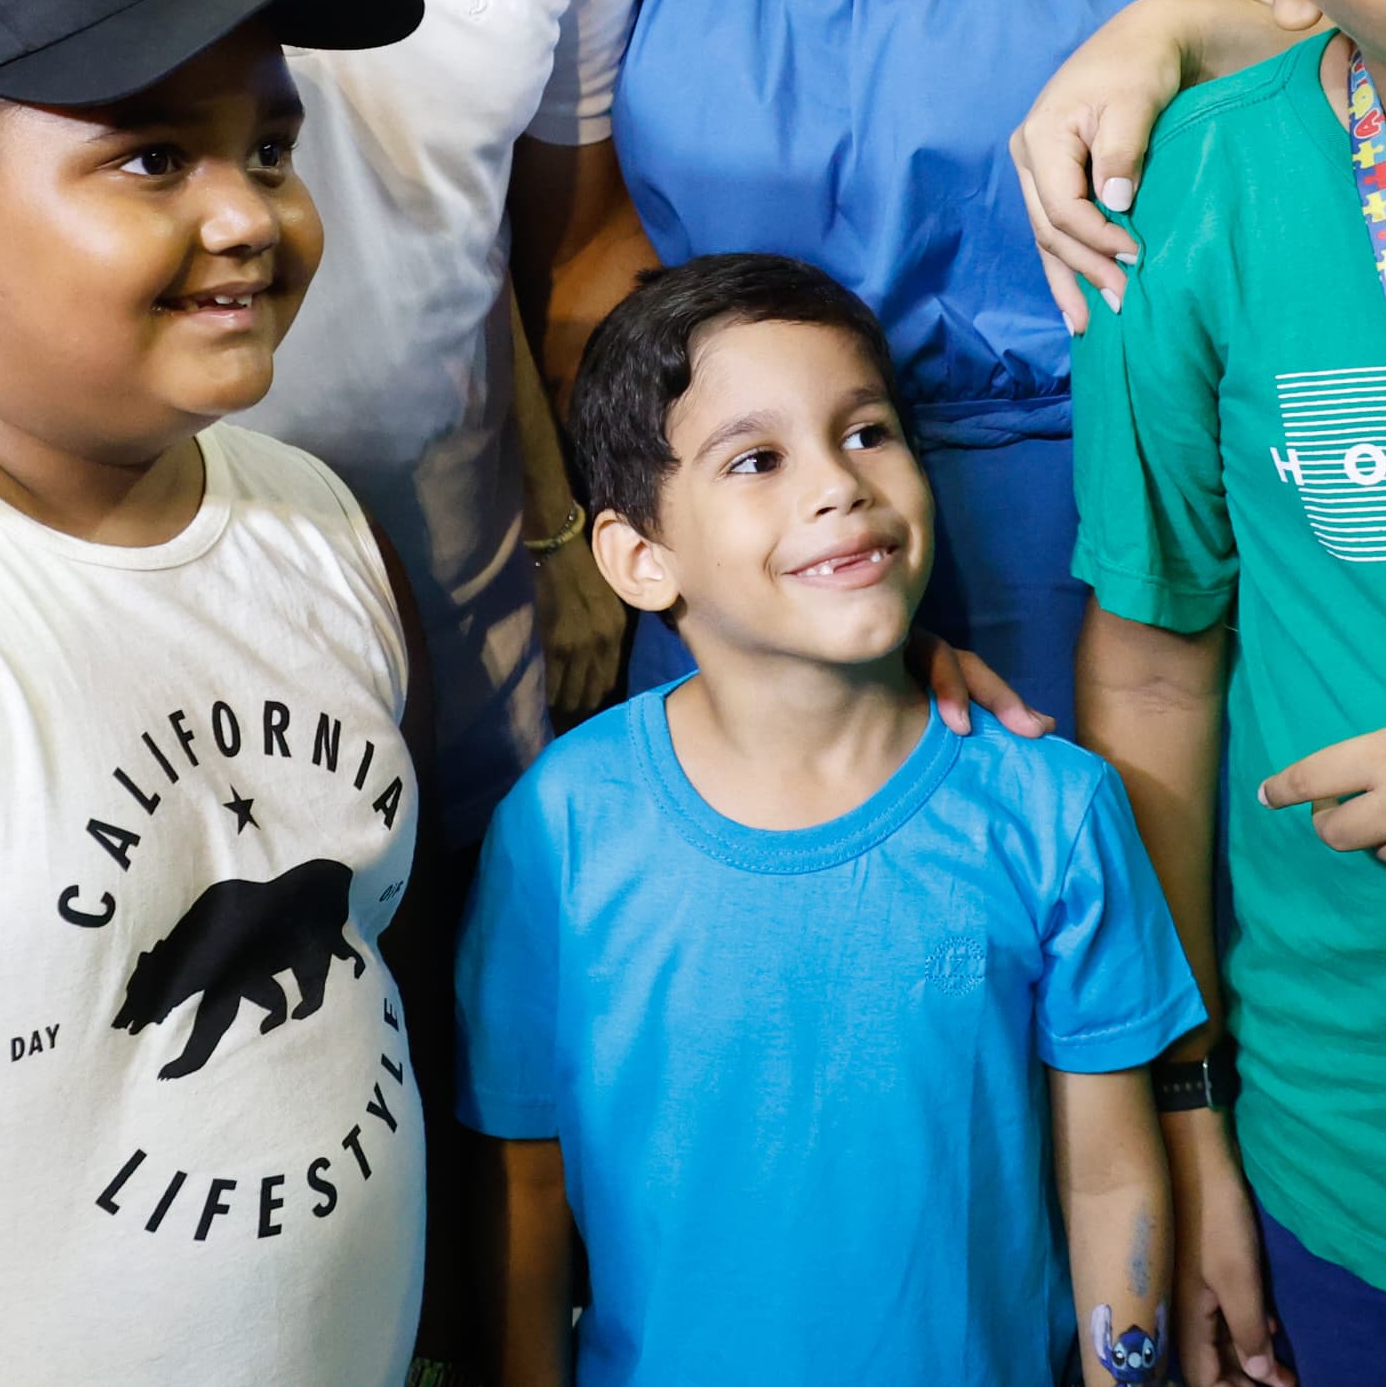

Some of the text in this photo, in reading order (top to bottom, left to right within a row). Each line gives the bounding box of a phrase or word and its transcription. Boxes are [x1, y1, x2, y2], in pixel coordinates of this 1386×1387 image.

[57, 699, 404, 929] CALIFORNIA
[10, 1024, 61, 1063] DAY
[95, 997, 404, 1242] LIFESTYLE
